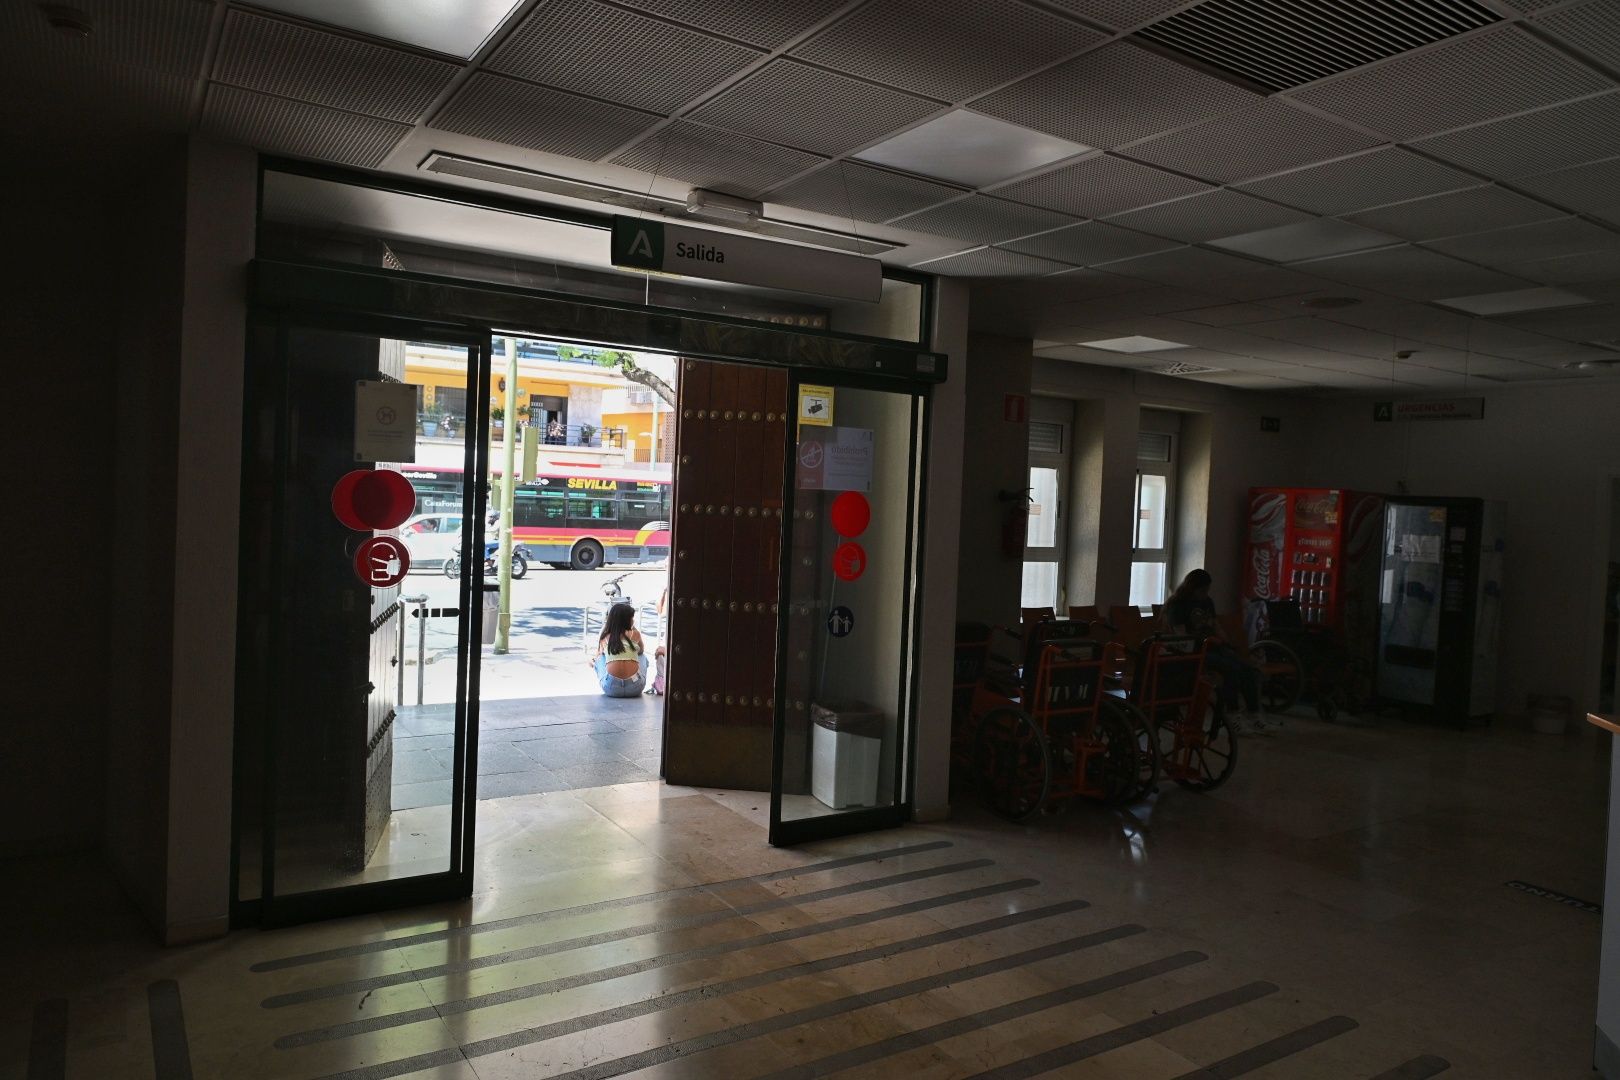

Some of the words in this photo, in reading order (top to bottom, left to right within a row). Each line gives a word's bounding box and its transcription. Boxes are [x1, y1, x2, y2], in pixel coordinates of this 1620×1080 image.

[676, 242, 725, 264] Salida
[1397, 402, 1456, 412] URGENCIAS
[567, 478, 617, 490] SEVILLA
